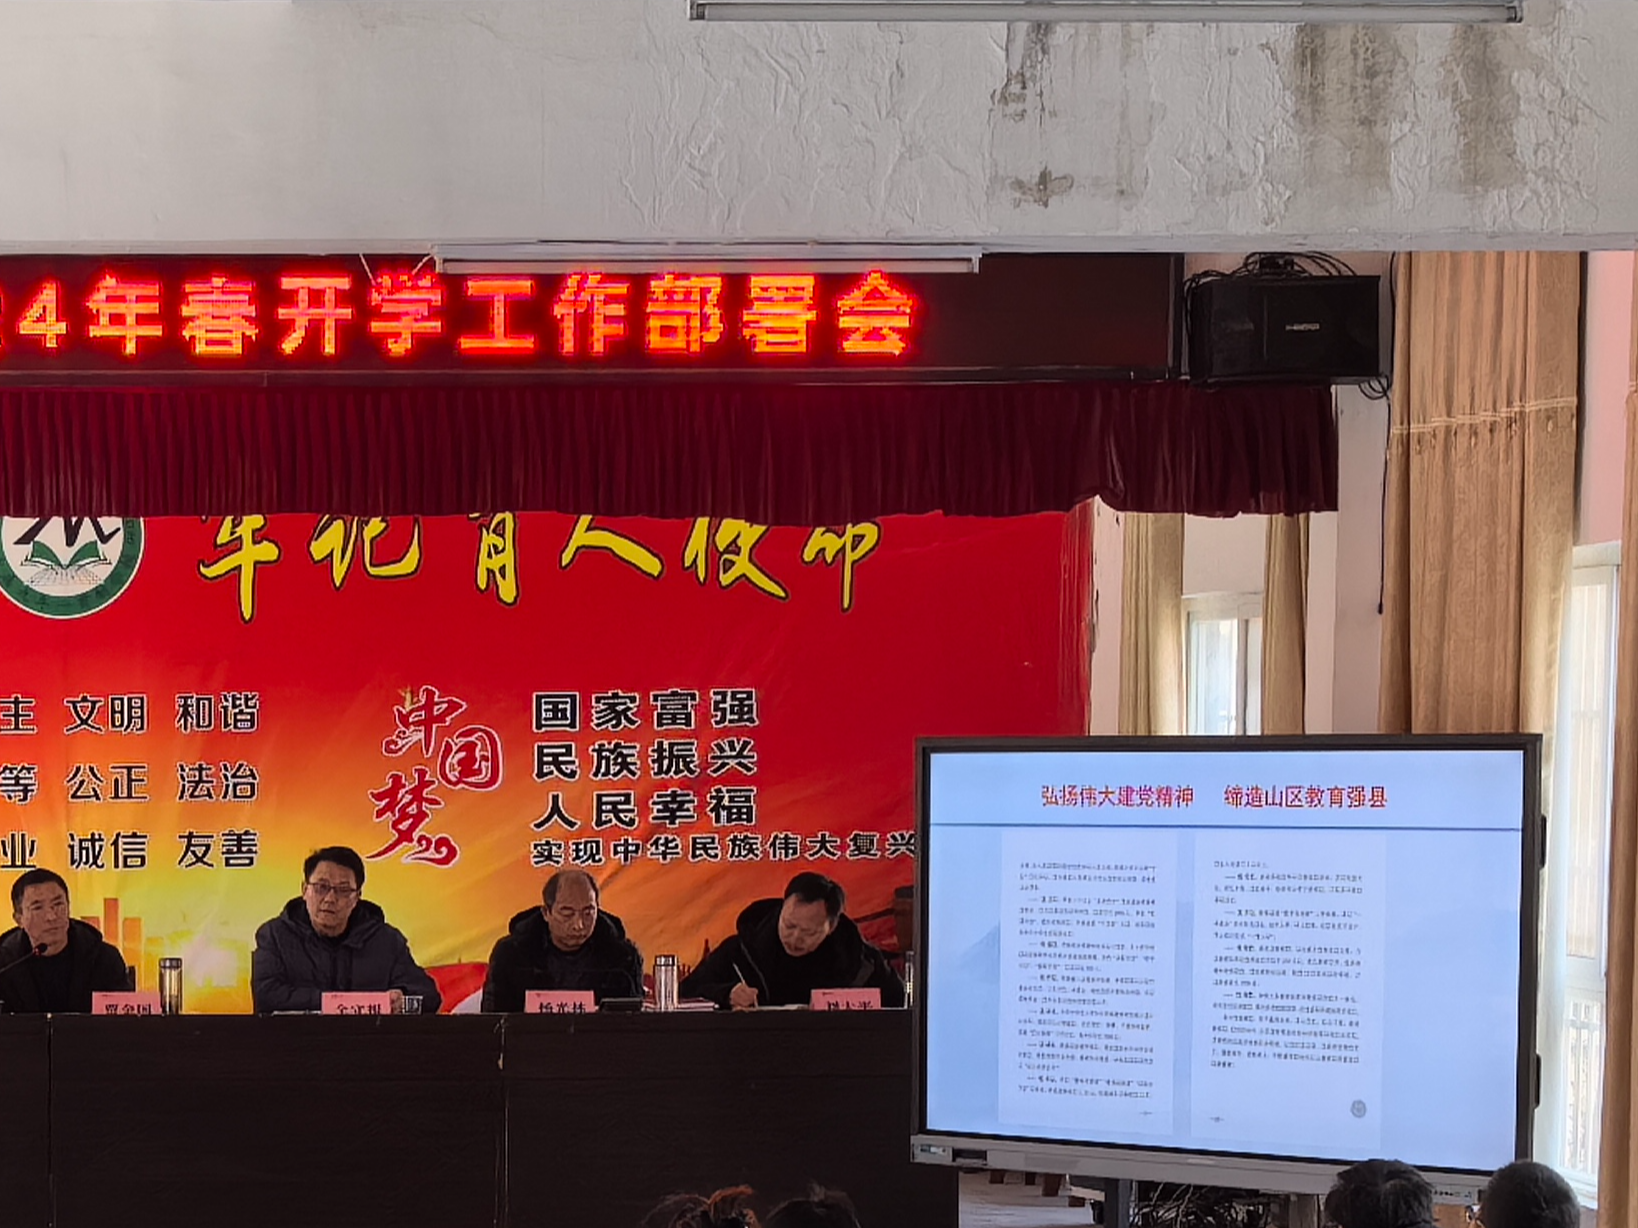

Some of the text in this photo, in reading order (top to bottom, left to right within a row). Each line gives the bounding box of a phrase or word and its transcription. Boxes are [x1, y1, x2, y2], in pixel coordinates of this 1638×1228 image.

[63, 693, 149, 733] 文明
[175, 691, 260, 733] 和谐
[531, 688, 759, 732] 国家富强
[531, 738, 758, 782] 民族振兴
[63, 764, 149, 802] 公正
[175, 761, 260, 802] 法治
[1041, 784, 1388, 808] 弘扬伟大建党精神 缔造山区教育强县
[529, 787, 757, 831] 人民幸福
[63, 831, 149, 870] 诚信
[175, 829, 260, 870] 友善
[529, 831, 915, 867] 实现中华民族伟大复兴
